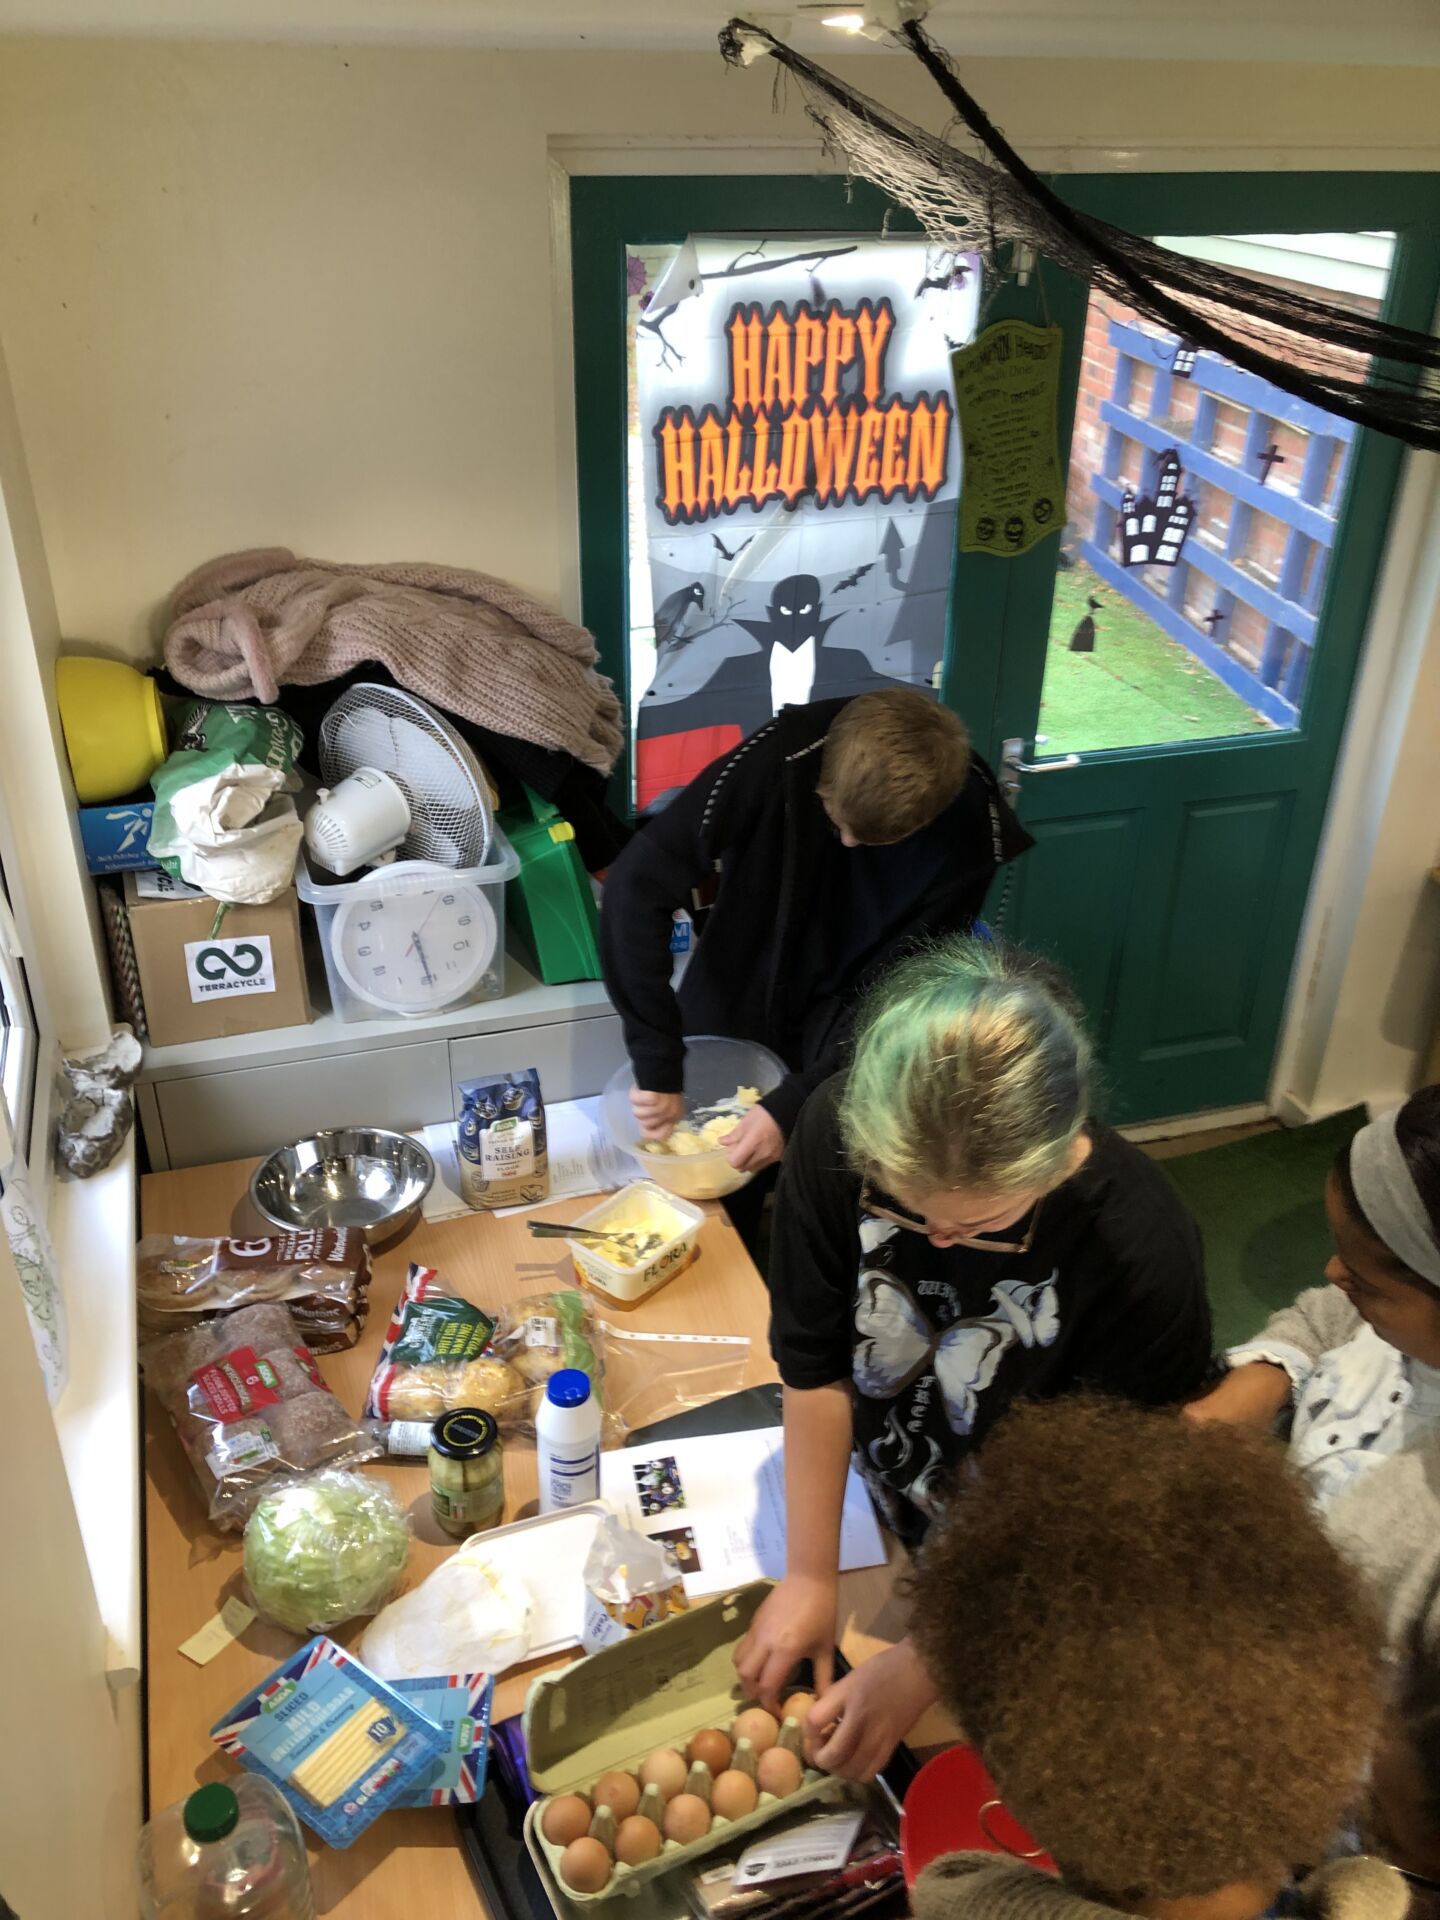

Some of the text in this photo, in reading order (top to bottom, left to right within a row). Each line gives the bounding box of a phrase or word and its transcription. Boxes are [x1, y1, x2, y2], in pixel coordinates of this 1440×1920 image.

[726, 298, 896, 416] HAPPY
[655, 391, 952, 524] HALLOWEEN
[198, 978, 266, 992] TERRACYCLE
[485, 1149, 530, 1162] RAISING
[495, 1145, 520, 1154] SELF
[229, 1237, 271, 1257] 6
[295, 1229, 315, 1260] ROLL
[643, 1242, 687, 1282] FLORA
[268, 1688, 293, 1710] ASDA
[274, 1692, 309, 1722] SLICED
[285, 1701, 321, 1733] MILD
[370, 1722, 388, 1737] 10
